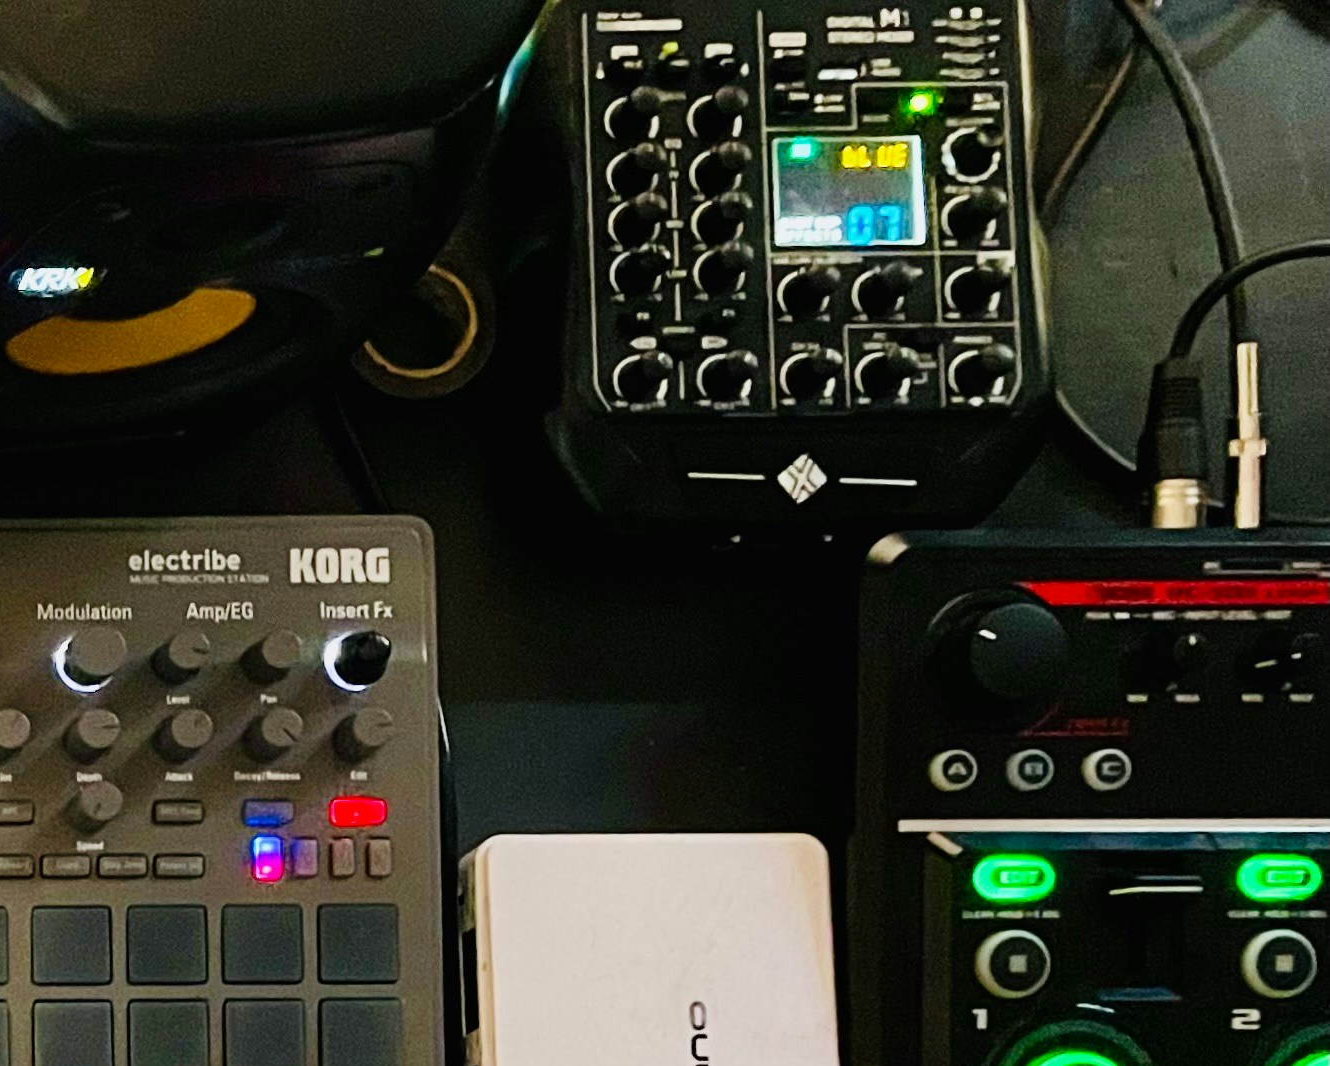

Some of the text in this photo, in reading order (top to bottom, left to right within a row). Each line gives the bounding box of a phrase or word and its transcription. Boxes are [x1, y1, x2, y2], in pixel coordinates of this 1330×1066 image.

[847, 204, 902, 244] 07
[18, 267, 88, 292] KRK
[128, 549, 241, 571] electribe
[289, 547, 390, 583] KORG
[36, 604, 133, 622] Modulation
[186, 603, 254, 624] Amp/EG
[319, 603, 394, 620] Insert Fx
[972, 1008, 989, 1030] 1
[1230, 1008, 1262, 1031] 2
